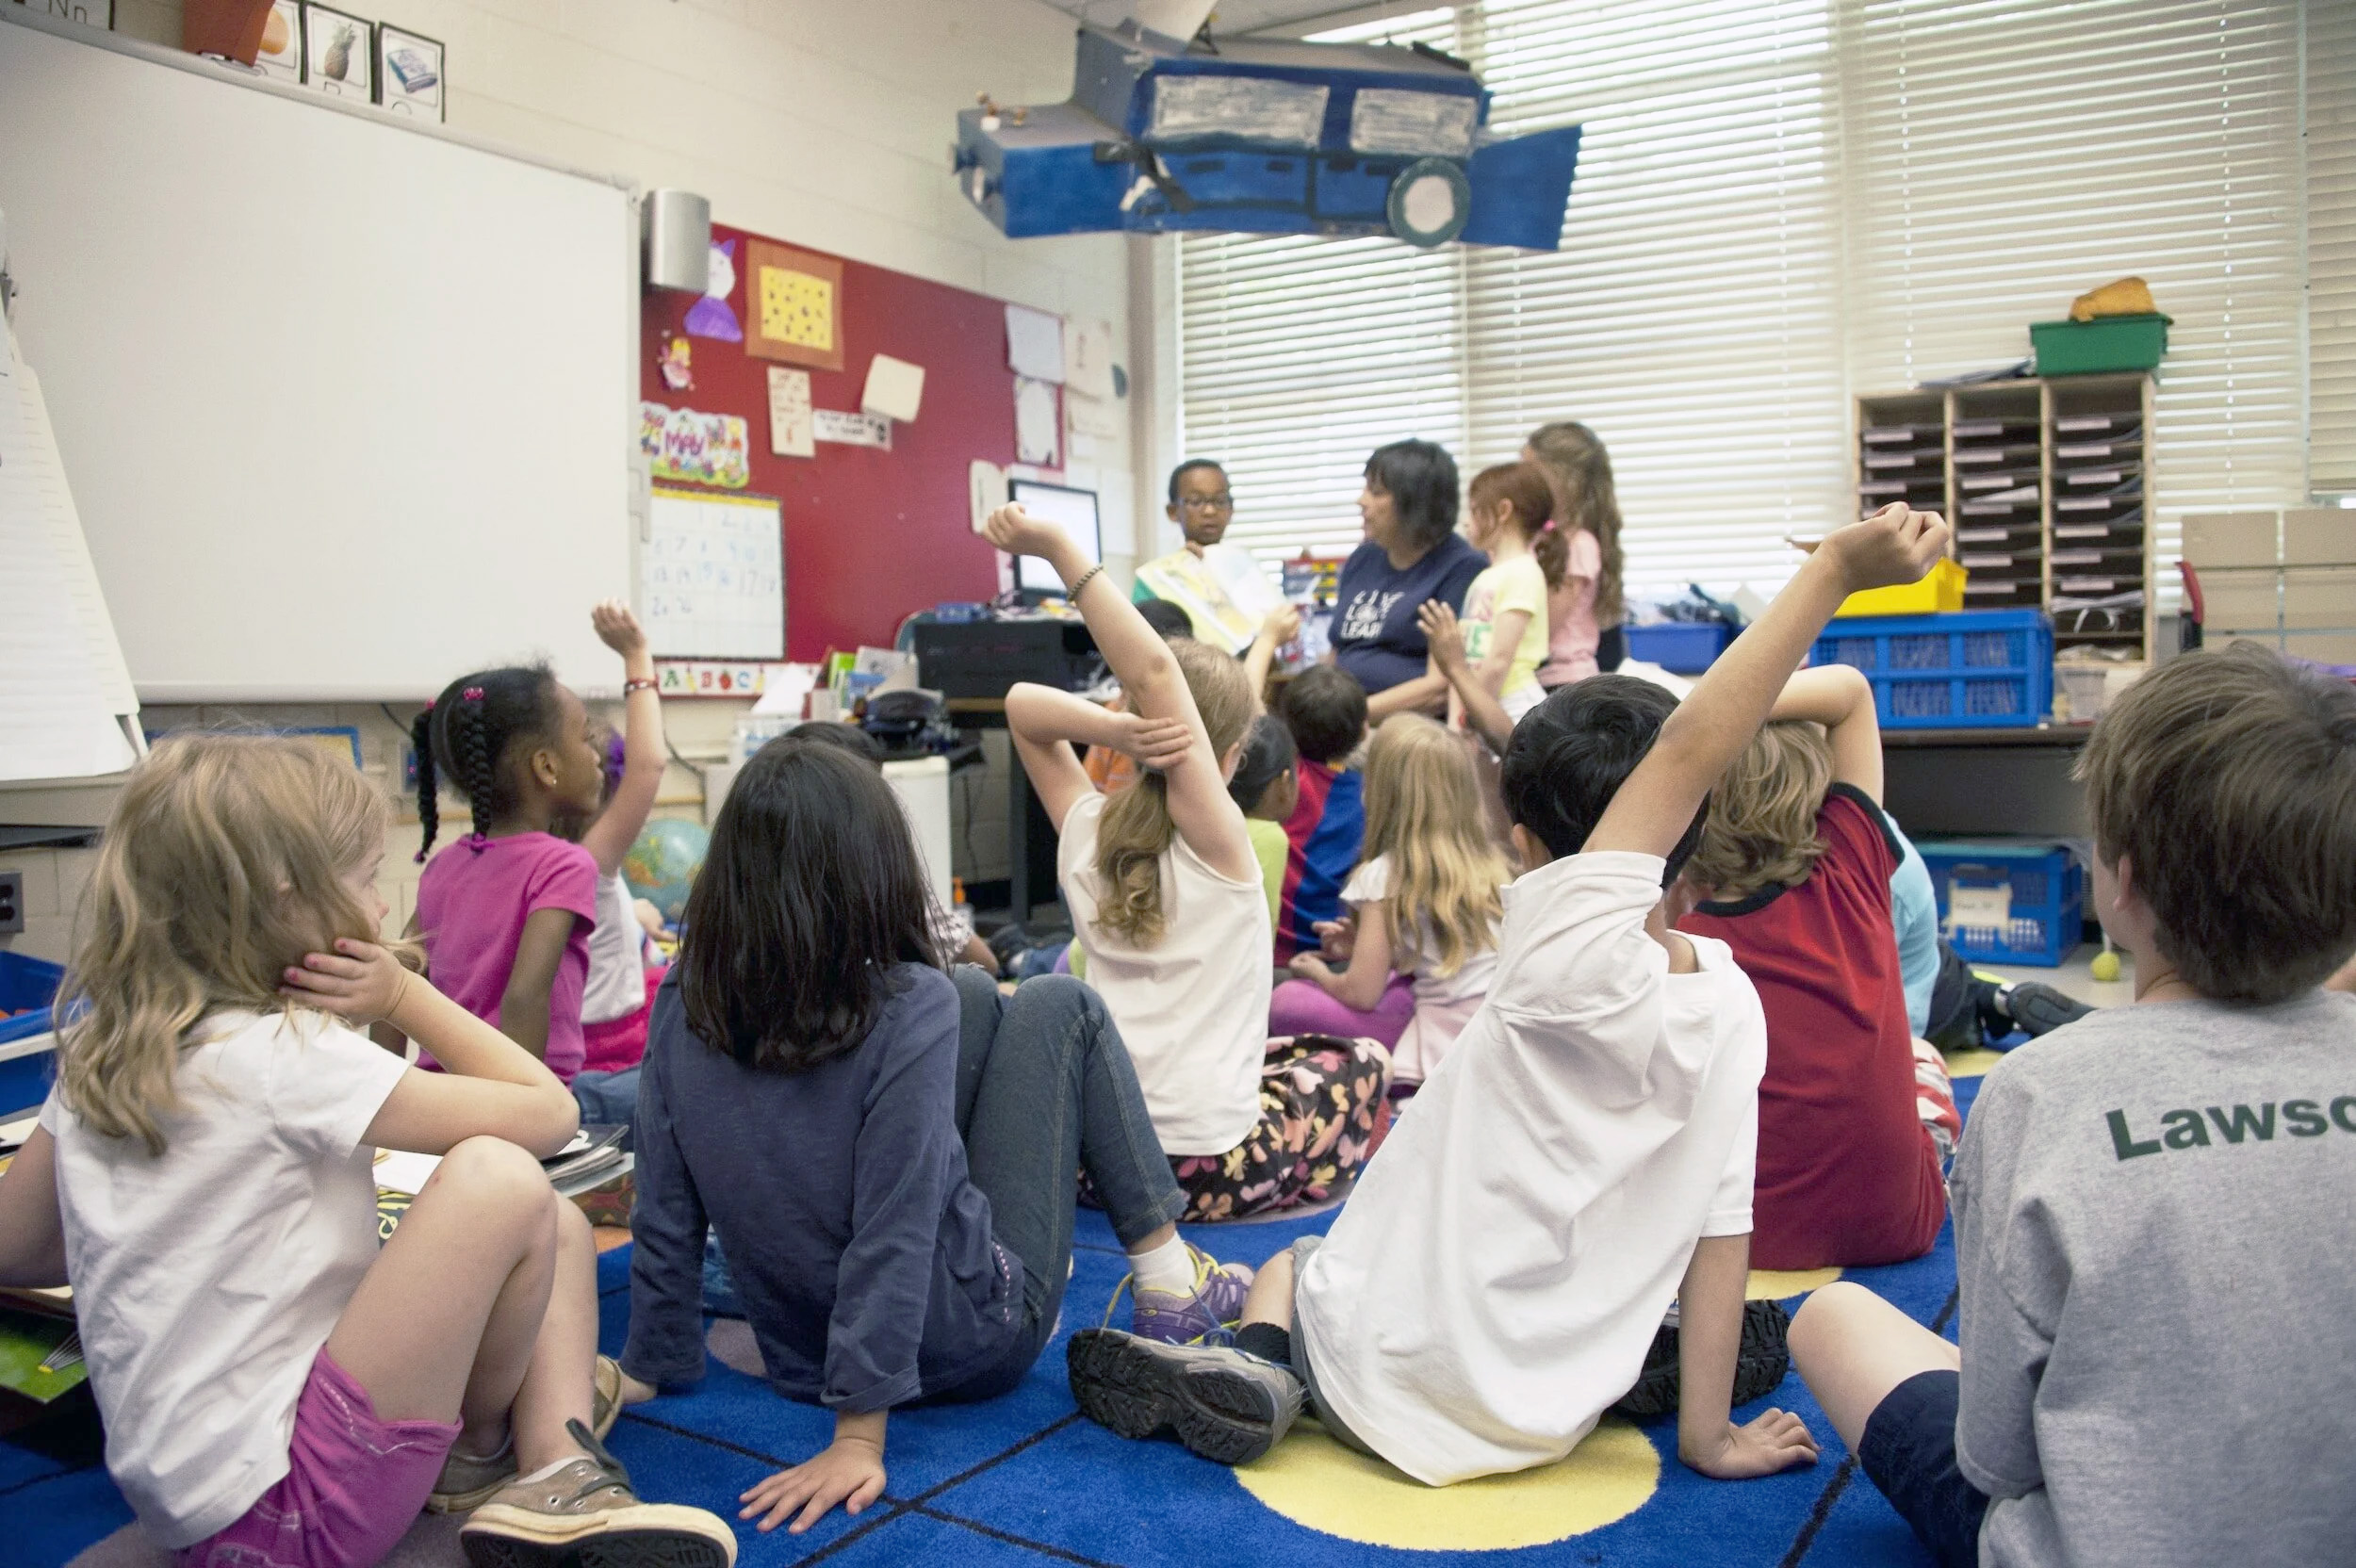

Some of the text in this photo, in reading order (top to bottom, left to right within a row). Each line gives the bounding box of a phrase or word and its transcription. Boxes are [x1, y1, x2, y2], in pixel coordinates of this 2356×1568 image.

[1340, 619, 1383, 639] LEAR
[663, 668, 679, 688] A
[736, 670, 751, 688] C
